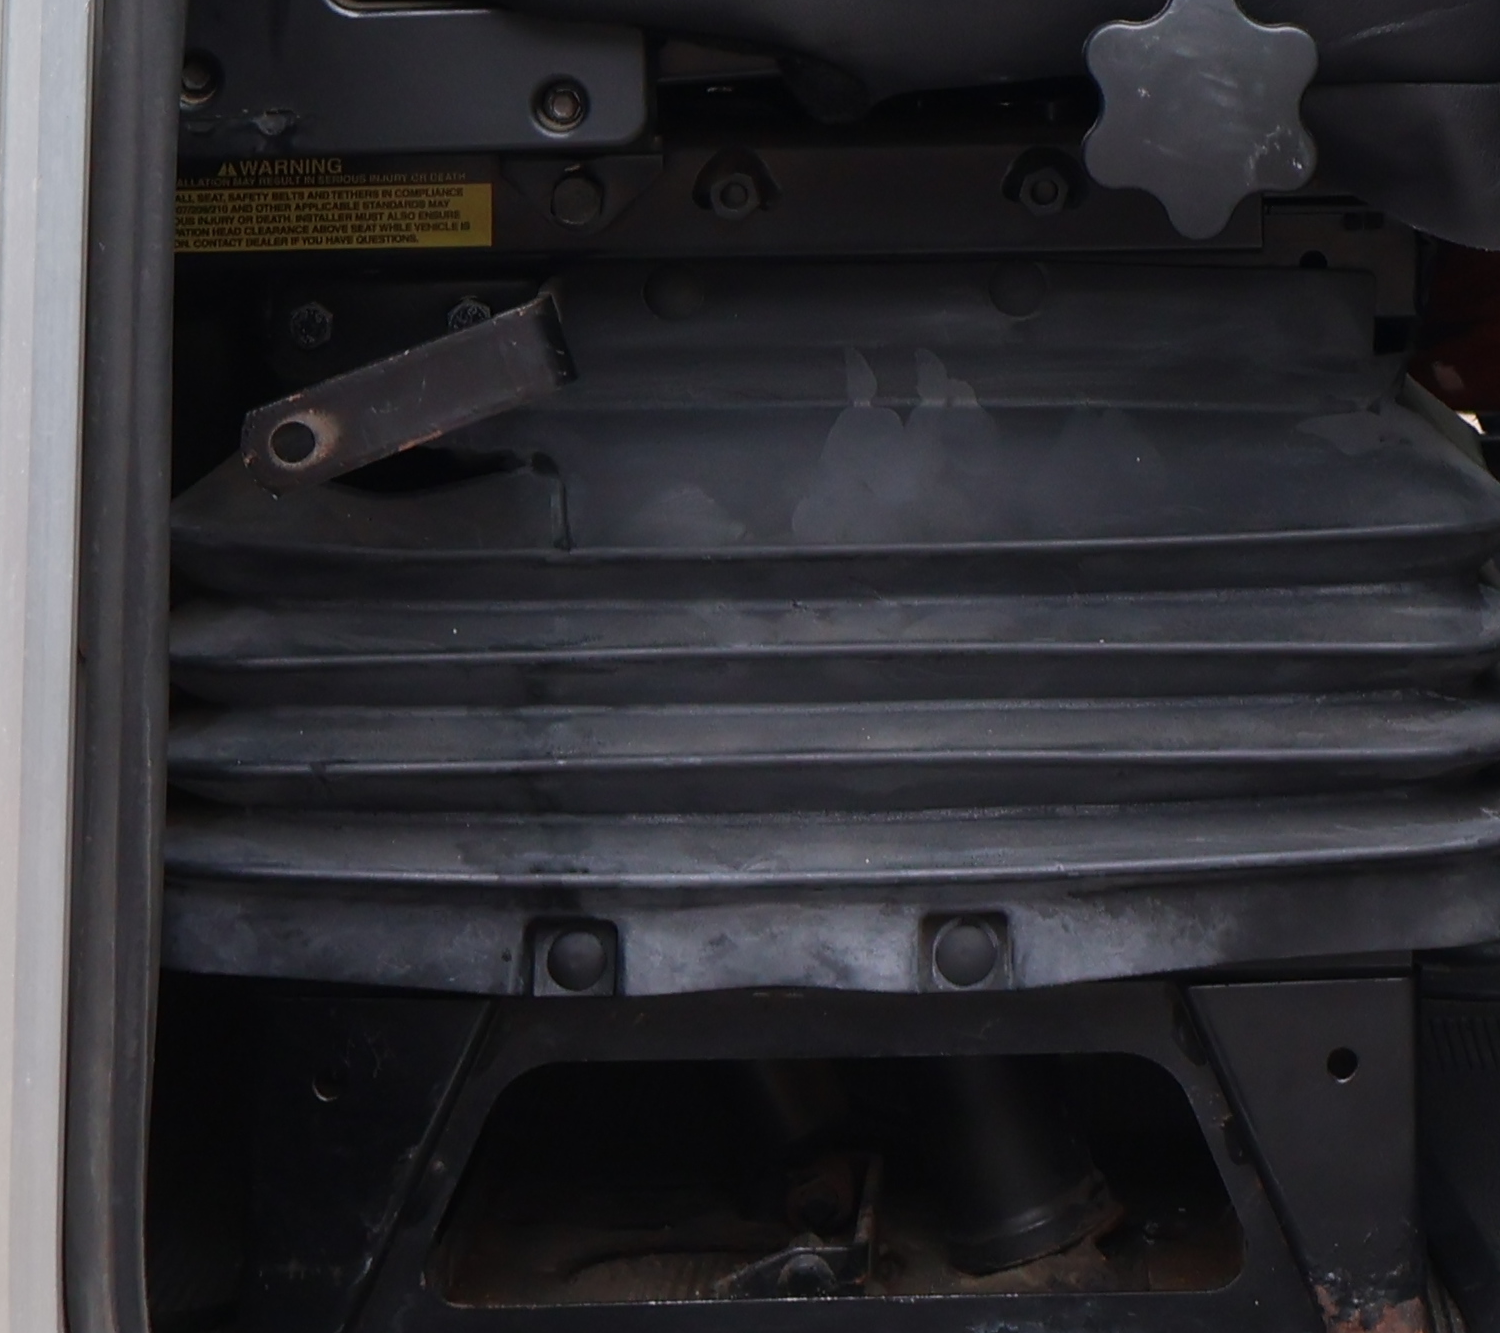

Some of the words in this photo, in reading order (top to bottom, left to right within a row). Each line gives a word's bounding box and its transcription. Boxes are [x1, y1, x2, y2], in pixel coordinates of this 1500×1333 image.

[240, 158, 342, 175] WARNING
[232, 176, 256, 187] MAY
[258, 175, 301, 186] RESULT
[303, 175, 316, 185] IN
[318, 174, 366, 185] SERIOUS
[369, 172, 407, 183] INJURY
[411, 172, 428, 182] OR
[228, 191, 269, 202] SAFETY
[271, 190, 305, 201] BELTS
[307, 190, 330, 200] AND
[331, 189, 379, 199] TETHERS
[381, 188, 392, 198] IN
[394, 187, 463, 197] COMPLIANCE
[230, 204, 253, 214] AND
[255, 203, 291, 213] OTHER
[294, 201, 359, 212] APPLICABLE
[362, 200, 426, 210] STANDARDS
[428, 199, 450, 208] MAY
[197, 216, 235, 226] INJURY
[238, 215, 253, 225] OR
[295, 213, 352, 223] INSTALLER
[355, 212, 384, 222] MUST
[387, 211, 415, 221] ALSO
[418, 210, 460, 220] ENSURE
[212, 226, 241, 237] HEAD
[244, 225, 309, 236] CLEARANCE
[312, 224, 348, 234] ABOVE
[350, 223, 376, 233] SEAT
[379, 222, 412, 232] WHILE
[414, 221, 458, 231] VEHICLE
[460, 221, 470, 230] IS
[193, 238, 242, 248] CONTACT
[245, 236, 288, 247] DEALER
[290, 236, 300, 246] IF
[302, 236, 323, 246] YOU
[325, 235, 353, 245] HAVE
[356, 234, 419, 245] QUESTIONS.
